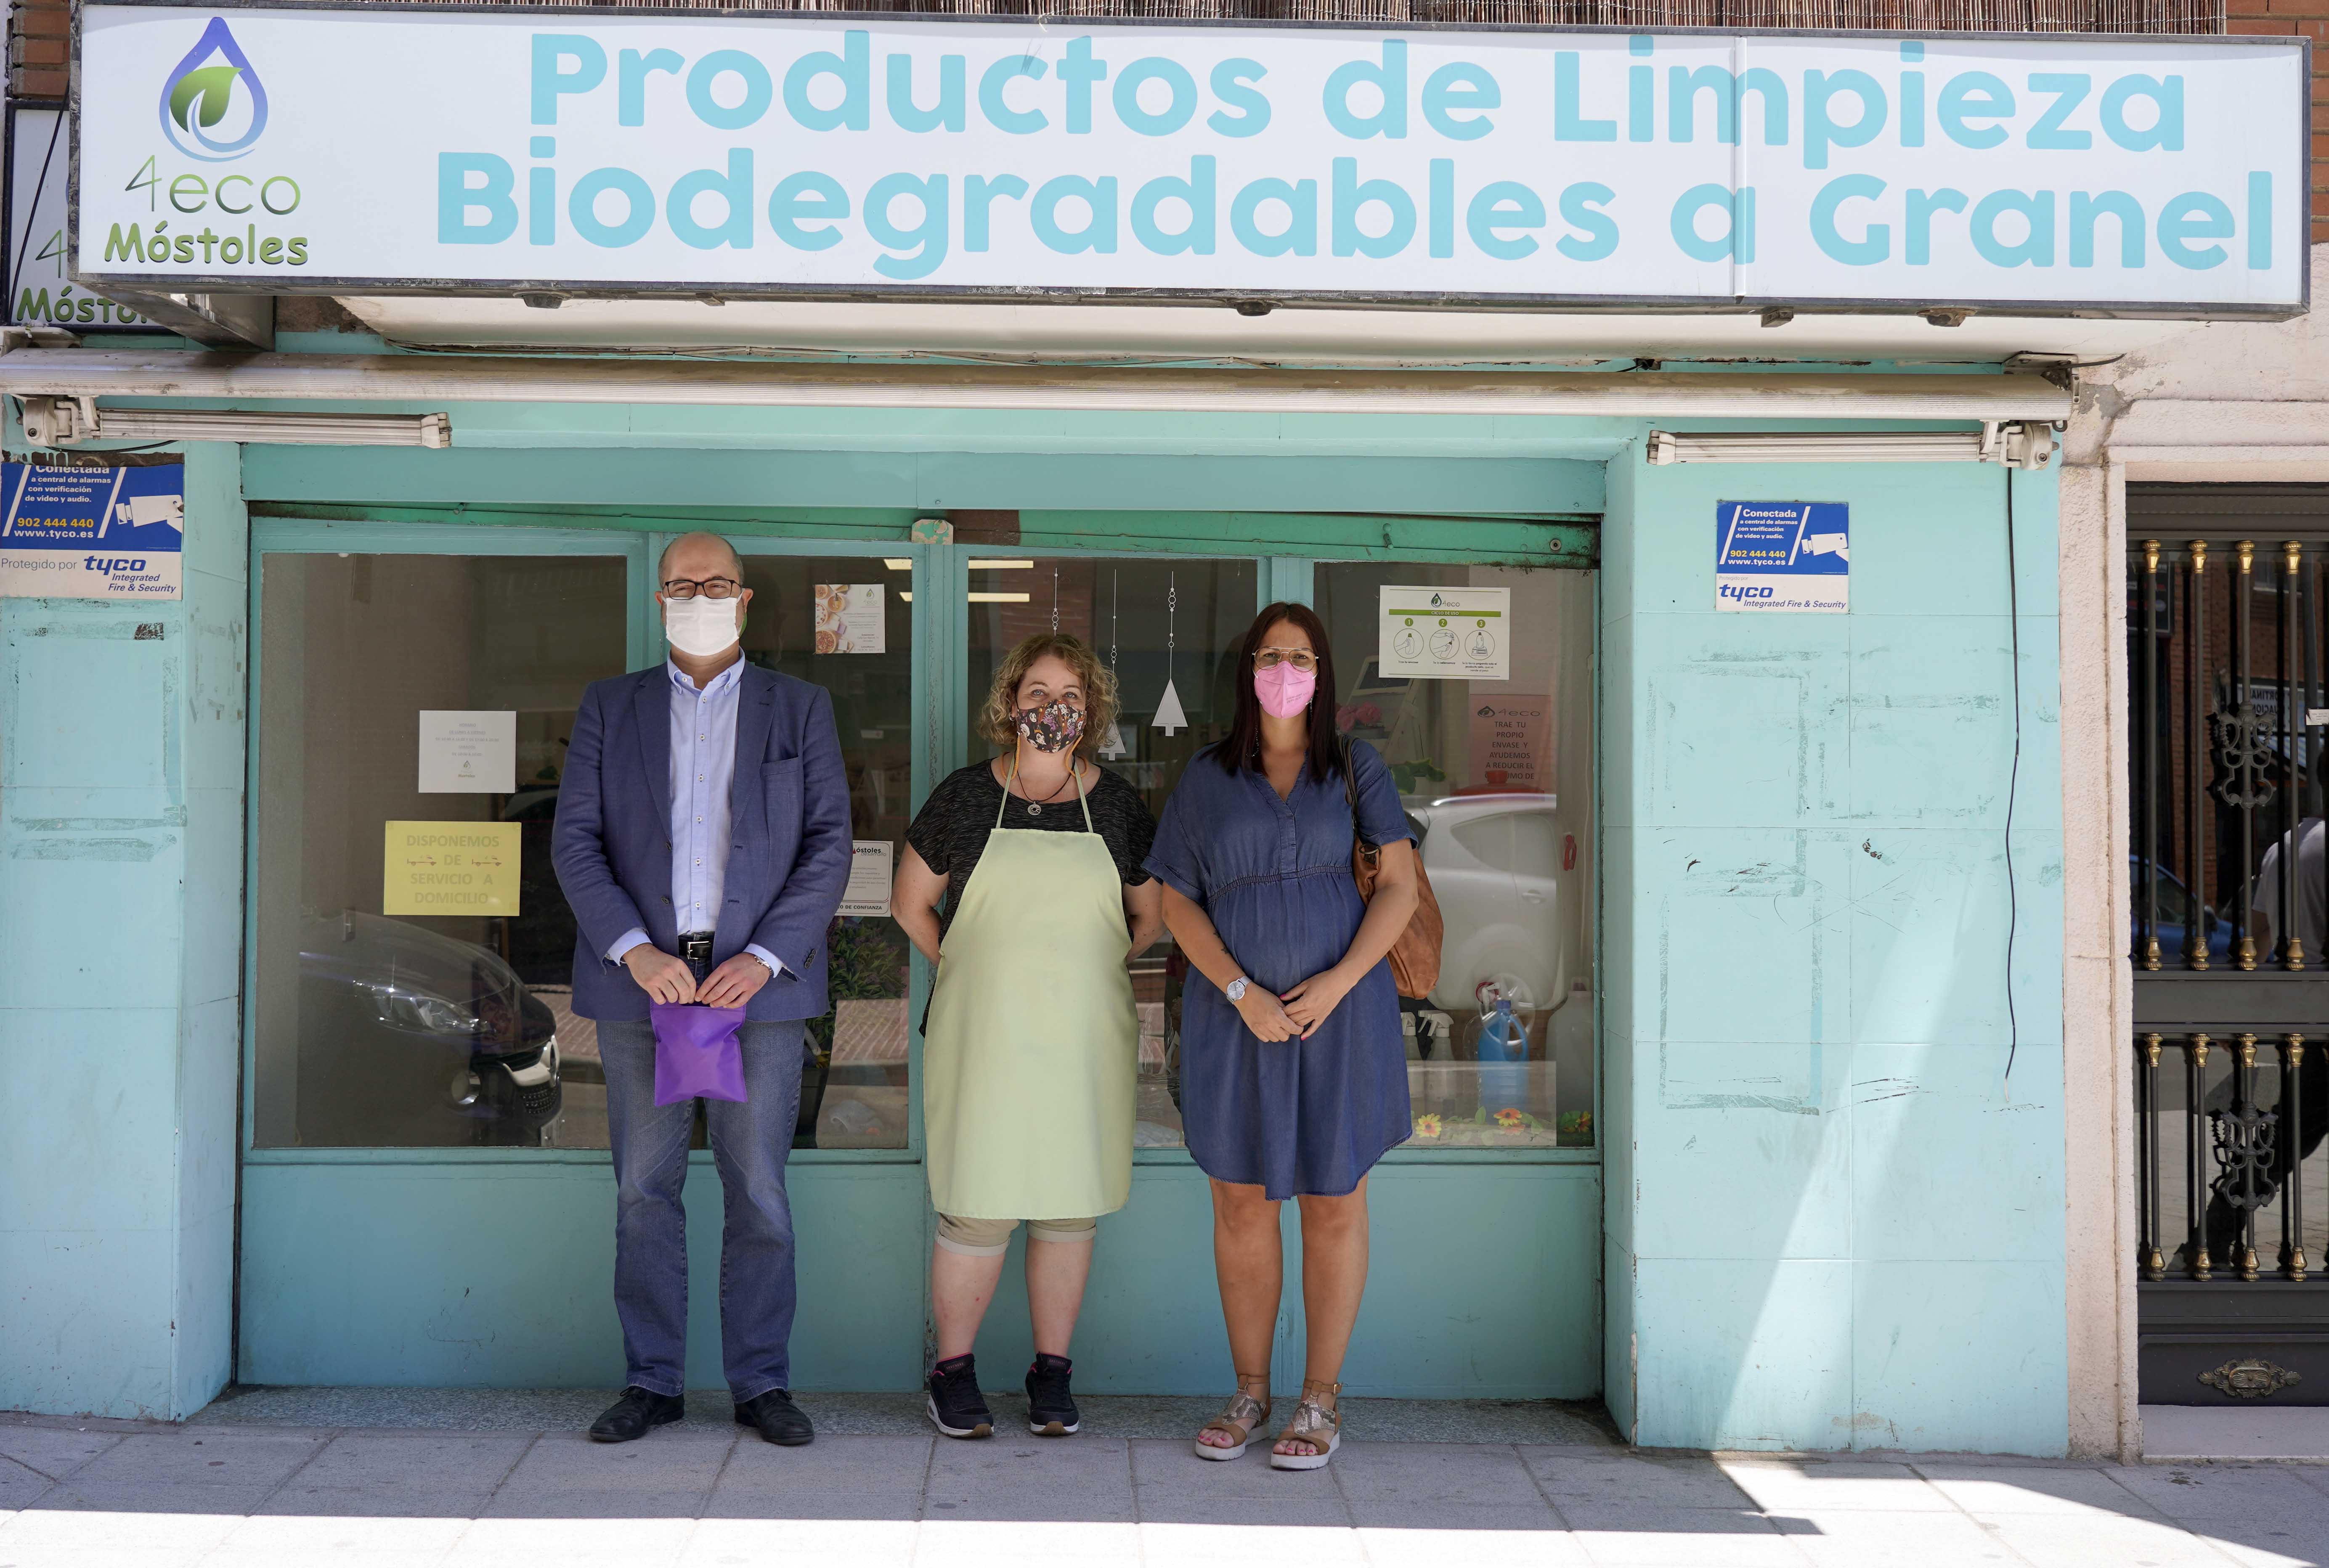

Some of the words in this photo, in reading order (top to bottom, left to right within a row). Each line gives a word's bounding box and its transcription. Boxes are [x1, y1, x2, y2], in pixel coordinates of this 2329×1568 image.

[530, 30, 1271, 138] Productos
[1323, 38, 1501, 142] de
[1554, 35, 2185, 169] Limpieza
[125, 154, 300, 215] 4eco
[438, 136, 1619, 280] Biodegradables
[1671, 183, 1756, 265] a
[1810, 170, 2273, 270] Granel
[105, 220, 308, 265] Móstoles
[18, 518, 40, 527] 902
[71, 519, 93, 527] 440
[14, 530, 93, 539] www.tyco.es
[2, 559, 55, 571] Protegido
[59, 562, 77, 571] por
[84, 556, 146, 575] tyco
[112, 573, 160, 583] Integrated
[138, 584, 176, 593] Security
[1719, 584, 1773, 601] tyco
[1813, 601, 1846, 609] Security
[407, 836, 499, 847] DISPONEMOS
[444, 855, 461, 866] DE
[411, 873, 472, 885] SERVICIO
[483, 874, 493, 885] A
[415, 893, 488, 904] DOMICILIO
